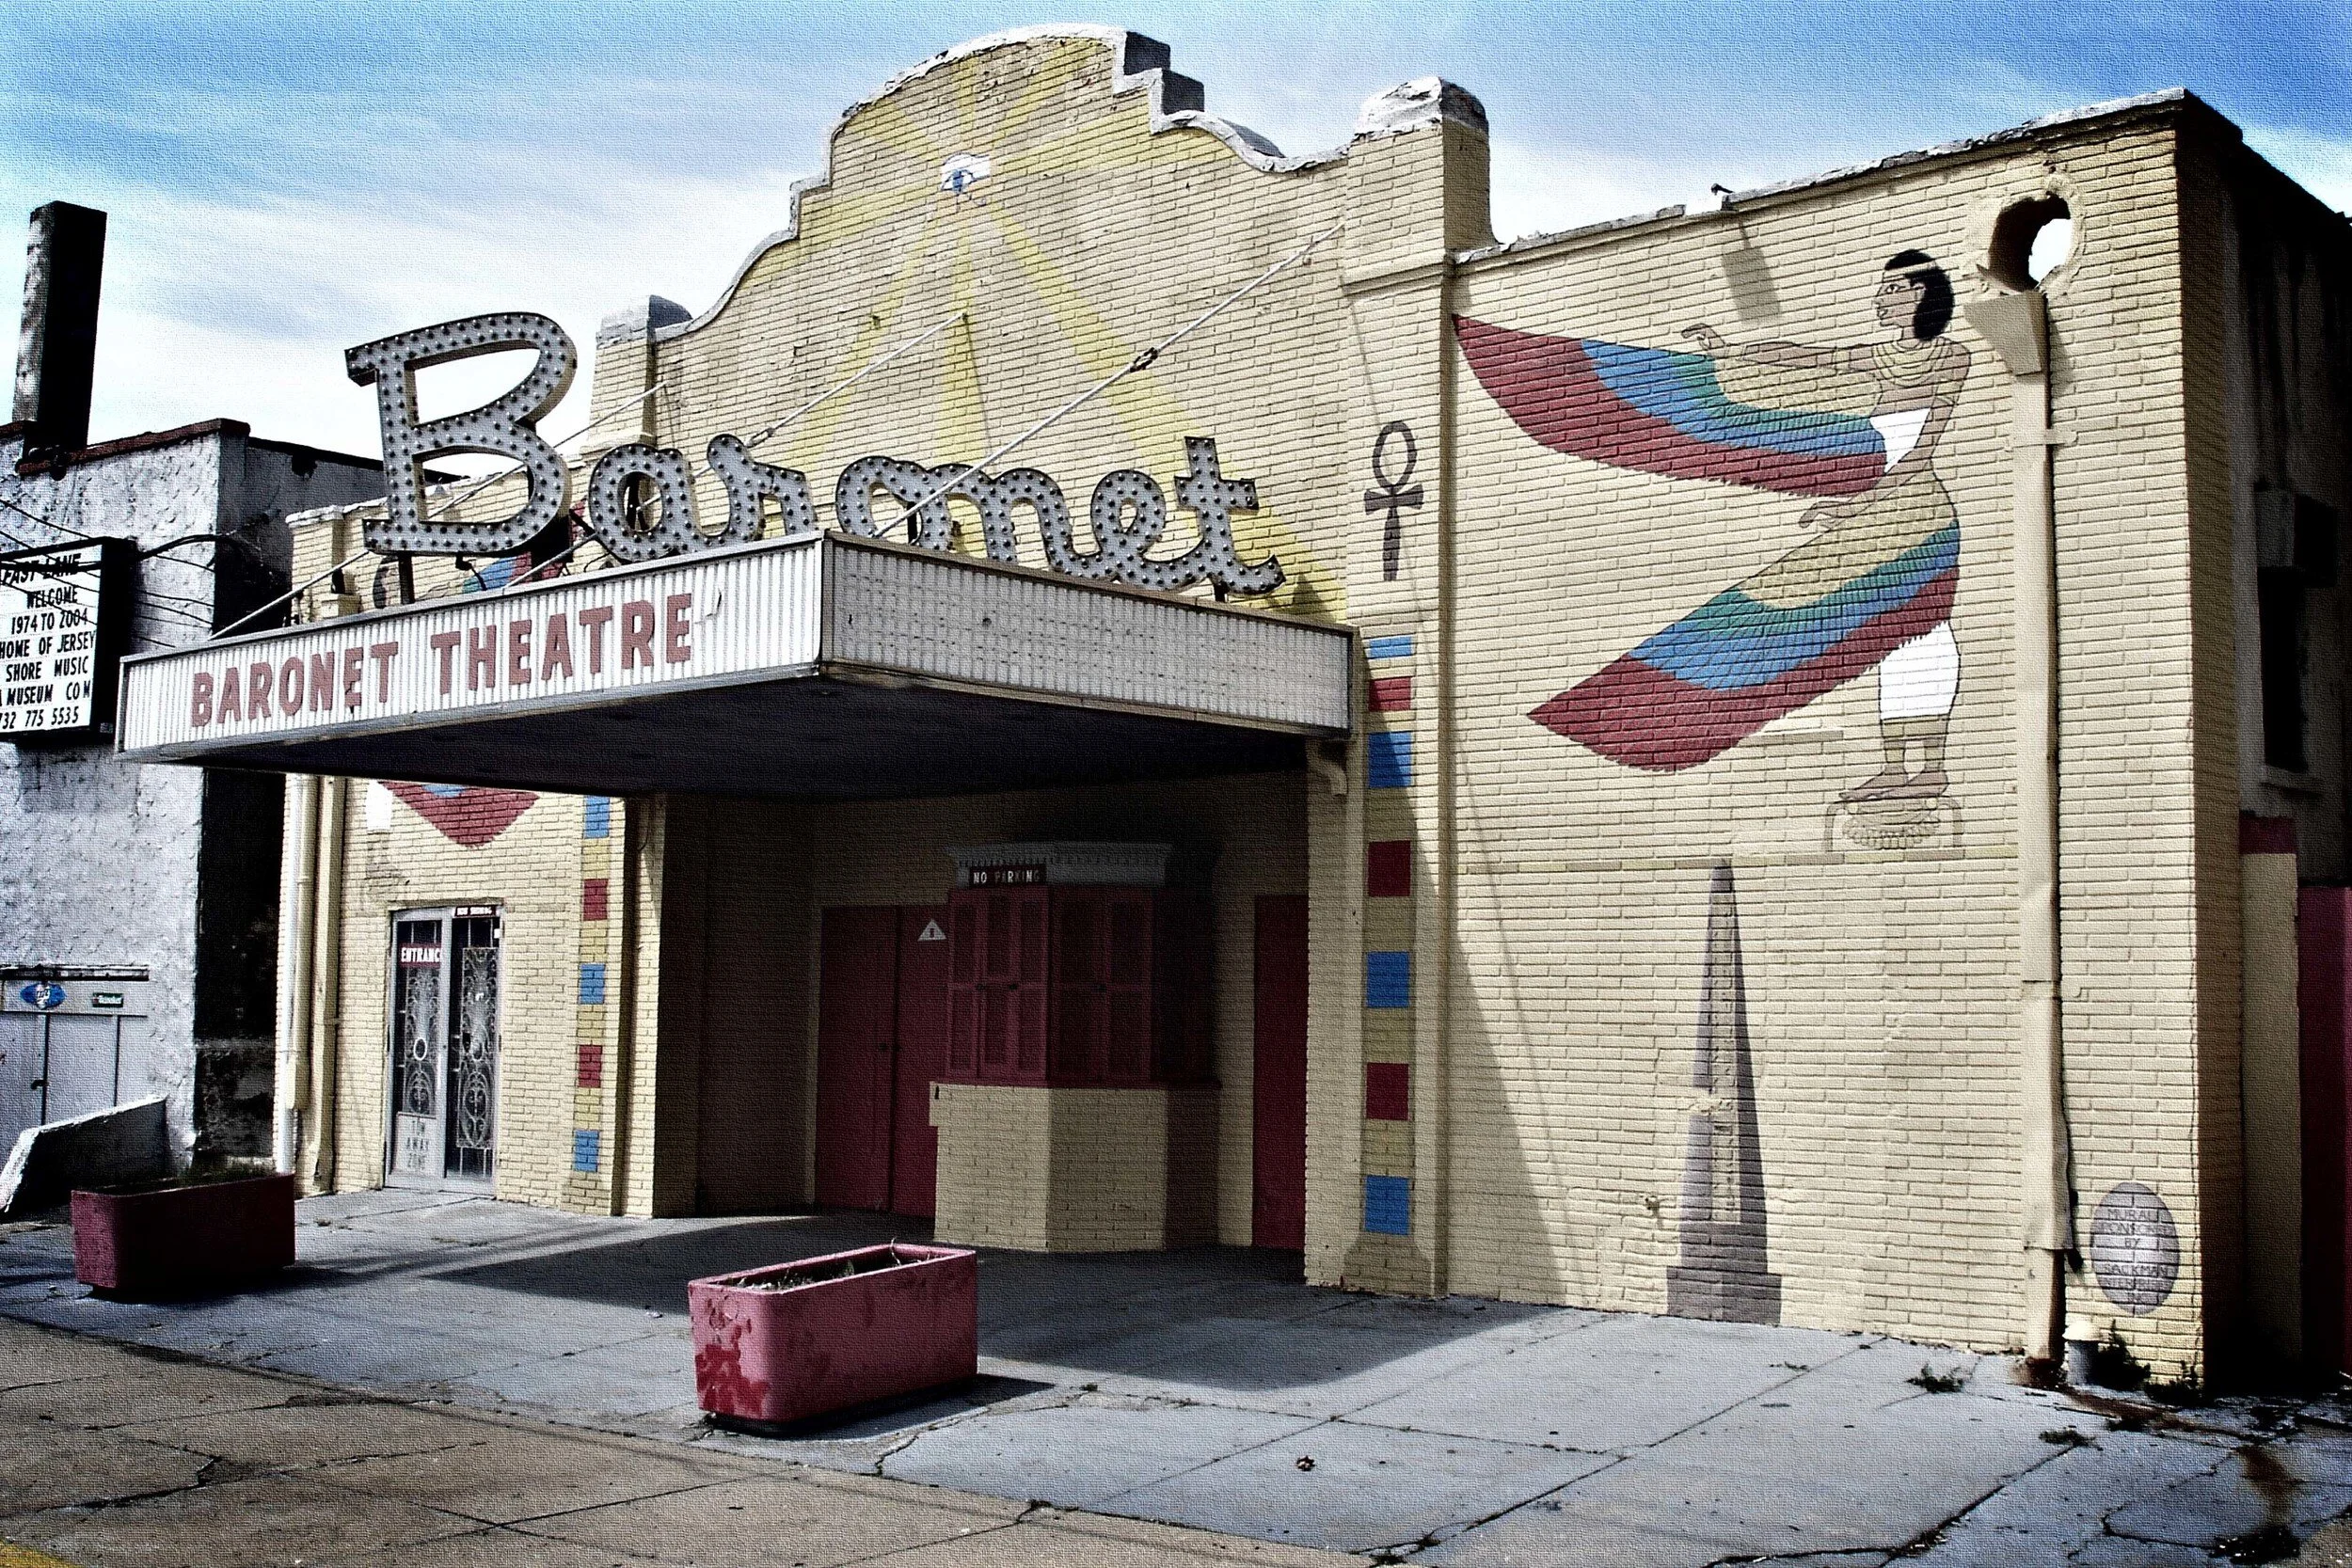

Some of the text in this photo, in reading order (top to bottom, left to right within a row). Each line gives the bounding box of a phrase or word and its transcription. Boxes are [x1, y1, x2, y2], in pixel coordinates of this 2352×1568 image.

[344, 311, 1287, 596] Baronet
[26, 585, 78, 610] WELCOME
[11, 608, 87, 635] 1974 TO 2004
[0, 630, 95, 659] HOME OF JERSEY
[6, 656, 88, 682] SHORE MUSIC
[191, 593, 692, 727] BARONET THEATRE
[7, 683, 54, 705] MUSEUM
[25, 709, 44, 728] 775
[51, 706, 79, 726] 5535
[973, 869, 1041, 884] NO PARKING
[401, 947, 441, 963] ENTRANC
[2107, 1209, 2152, 1221] MURAL
[2124, 1237, 2141, 1249] BY
